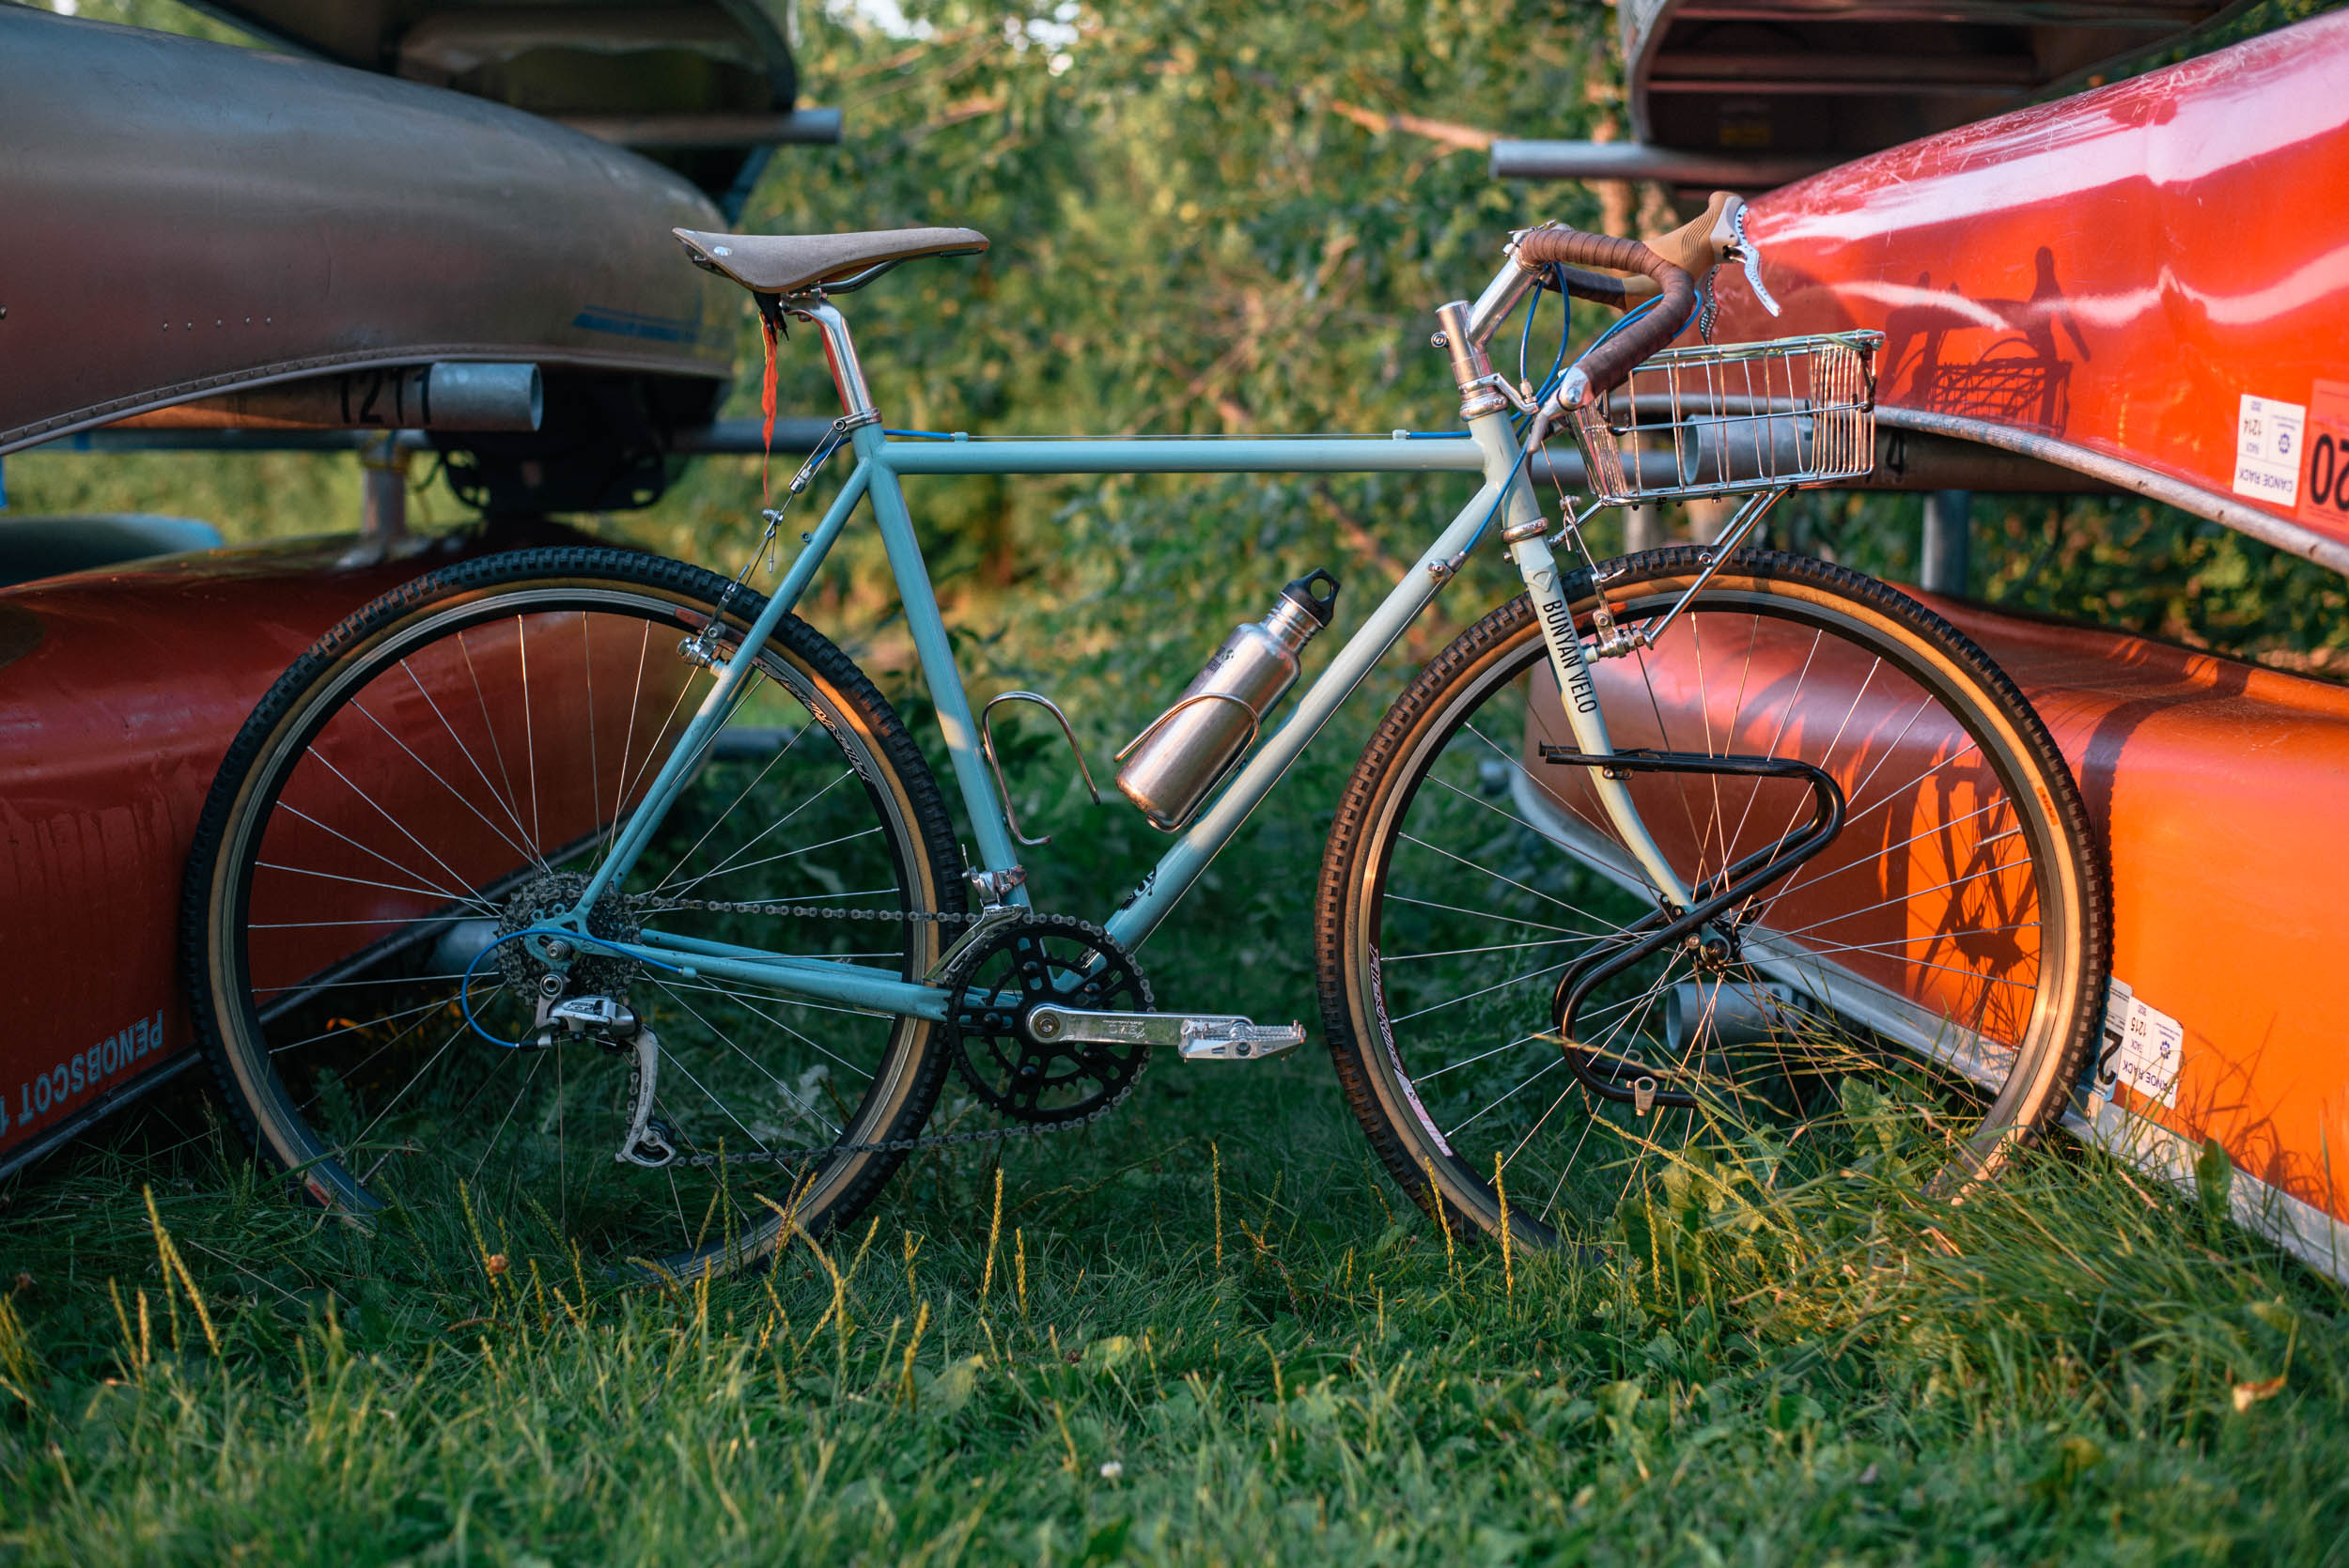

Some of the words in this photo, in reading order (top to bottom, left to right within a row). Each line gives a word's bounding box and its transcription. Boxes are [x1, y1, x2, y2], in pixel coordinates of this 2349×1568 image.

[2238, 467, 2261, 485] RACK
[2263, 473, 2294, 493] CANOE
[1543, 599, 1583, 669] BUNYAN
[1568, 670, 1597, 714] VELO
[2130, 1017, 2147, 1038] 1215
[18, 1009, 163, 1126] PENOBSCOT
